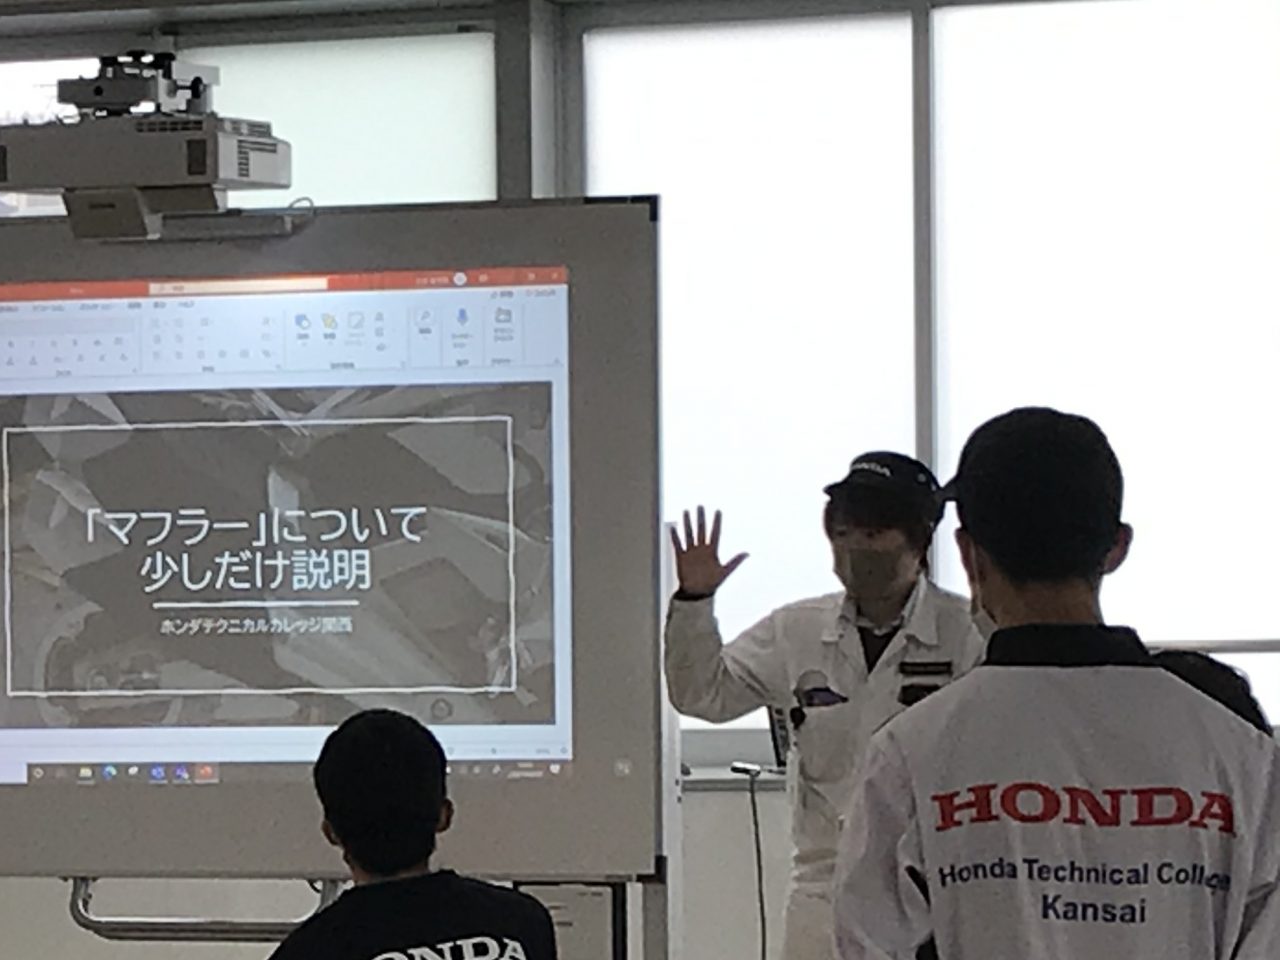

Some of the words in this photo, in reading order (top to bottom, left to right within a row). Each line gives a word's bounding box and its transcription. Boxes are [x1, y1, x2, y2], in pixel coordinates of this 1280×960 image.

[86, 506, 428, 547] 「マフラー」について
[140, 548, 372, 594] 少しだけ説明
[931, 781, 1238, 838] HONDA
[938, 857, 1018, 888] Honda
[1023, 858, 1149, 886] Technical
[1041, 894, 1148, 924] Kansai
